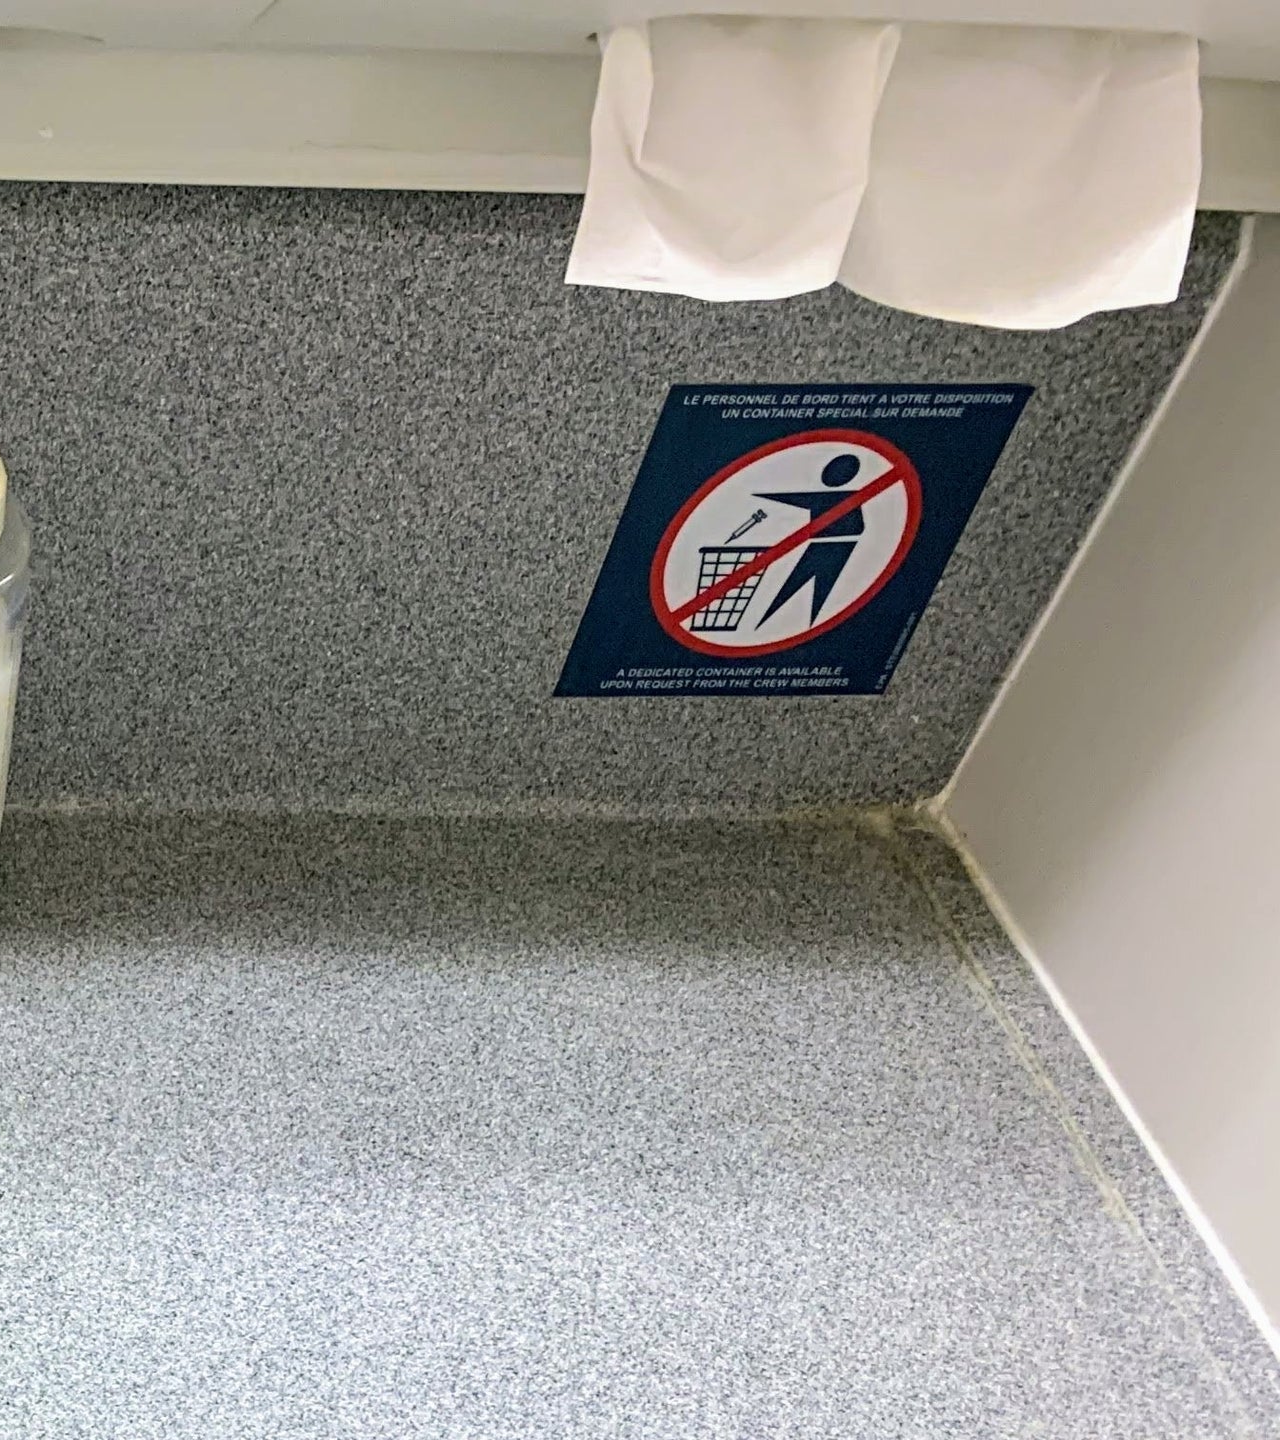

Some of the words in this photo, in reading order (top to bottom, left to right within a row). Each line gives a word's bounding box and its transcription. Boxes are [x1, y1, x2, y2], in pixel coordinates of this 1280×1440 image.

[683, 394, 701, 406] LE
[702, 394, 778, 405] PERSONNEL
[781, 394, 800, 405] DE
[801, 394, 839, 405] BORD
[841, 394, 877, 405] TIENT
[878, 394, 888, 405] A
[890, 393, 932, 404] VOTRE
[934, 393, 1015, 404] DISPOSITION
[721, 408, 741, 419] UN
[742, 408, 815, 419] CONTAINER
[816, 407, 869, 419] SPECIAL
[872, 407, 899, 418] SUR
[901, 407, 965, 418] DEMANDE
[616, 668, 625, 677] A
[627, 668, 694, 678] DEDICATED
[695, 667, 762, 677] CONTAINER
[764, 667, 777, 676] IS
[778, 666, 844, 676] AVAILABLE
[600, 679, 633, 689] UPON
[634, 679, 691, 689] REQUEST
[692, 679, 727, 688] FROM
[728, 679, 750, 688] THE
[753, 679, 789, 688] CREW
[790, 677, 850, 688] MEMBERS
